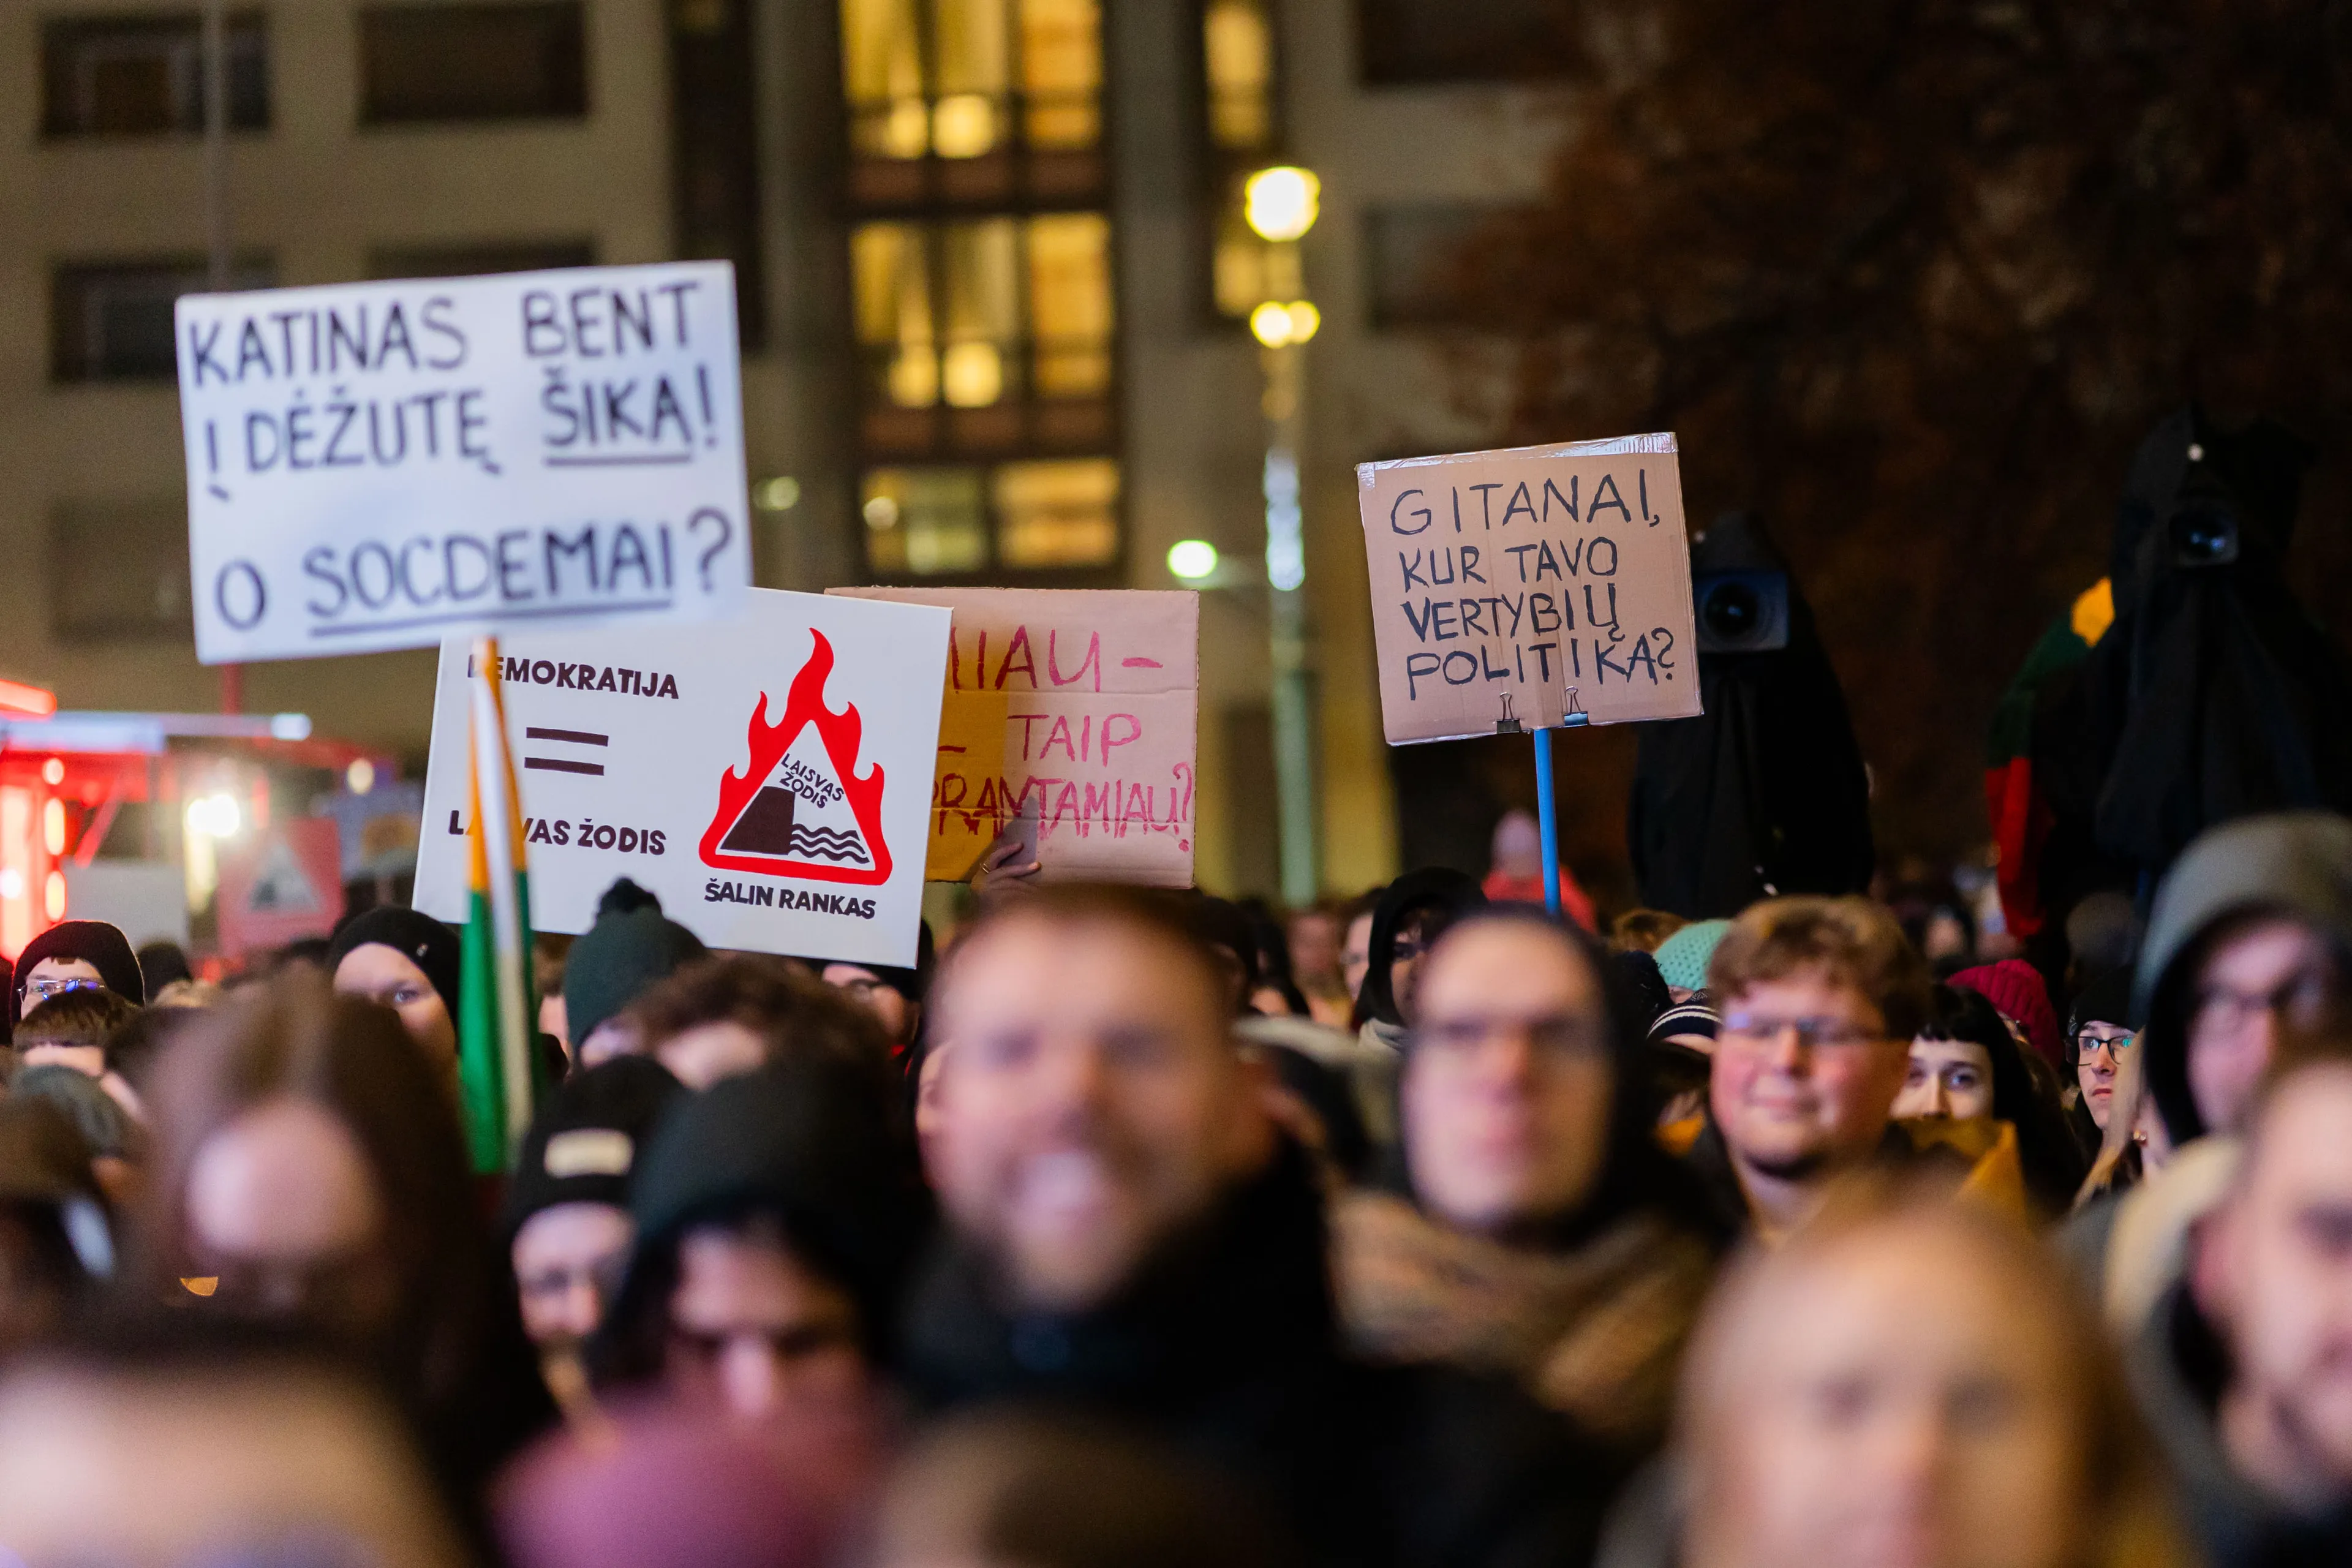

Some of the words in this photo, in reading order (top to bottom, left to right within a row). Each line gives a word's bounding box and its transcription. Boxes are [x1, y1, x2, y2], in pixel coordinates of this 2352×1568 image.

[189, 296, 470, 388] KATINAS
[521, 281, 704, 360] BENT
[244, 386, 503, 475] DĖŽUTĘ
[541, 365, 718, 448] ŠIKA!
[1390, 469, 1660, 535] GITANAI,
[214, 559, 267, 630] O
[303, 506, 733, 618] SOCDEMAI?
[1398, 546, 1487, 593] KUR
[1504, 537, 1618, 583] TAVO
[1401, 582, 1626, 643] VERTYBIŲ
[1406, 627, 1675, 701] POLITIKA?
[1007, 714, 1141, 767] TAIP
[779, 771, 828, 809] ŽODIS
[781, 753, 844, 801] LAISVAS
[933, 762, 1193, 852] RANTAMIAU?
[578, 818, 666, 855] ŽODIS
[704, 878, 774, 907] ŠALIN
[778, 889, 876, 919] RANKAS
